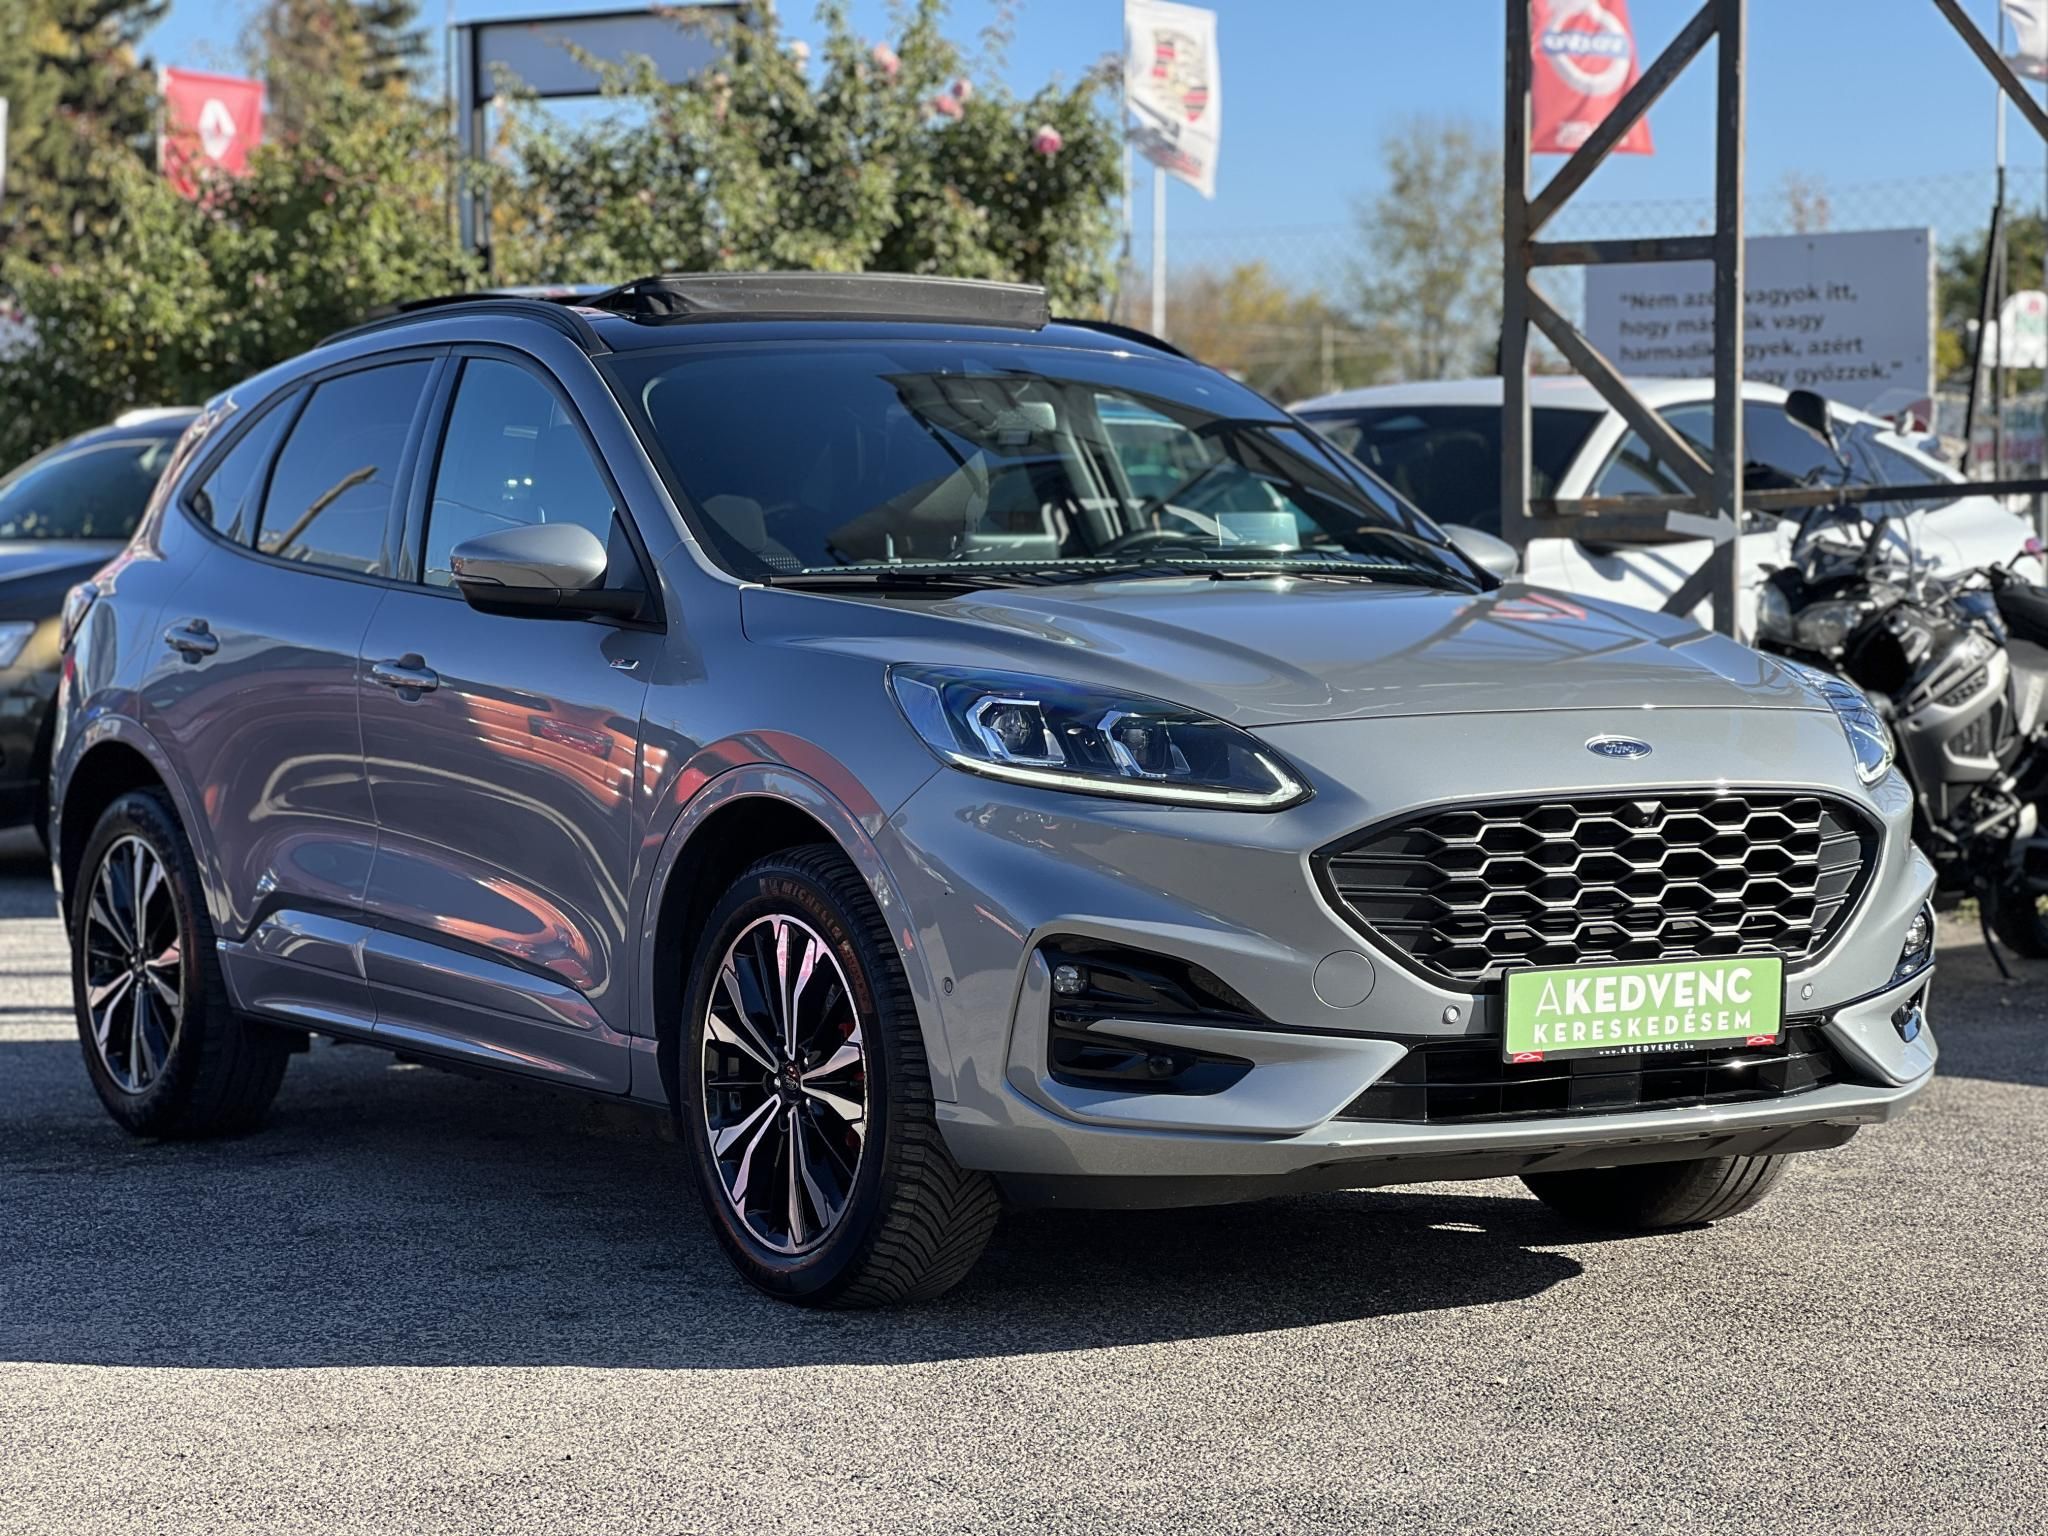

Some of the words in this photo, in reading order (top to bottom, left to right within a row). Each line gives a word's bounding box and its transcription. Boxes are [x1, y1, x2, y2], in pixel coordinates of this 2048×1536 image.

[1620, 320, 1670, 340] hogy
[1773, 314, 1824, 333] vagy
[1603, 742, 1637, 754] Ford
[1535, 967, 1753, 1017] AKEDVENC
[1533, 1006, 1751, 1044] KERESKEDÉSEM
